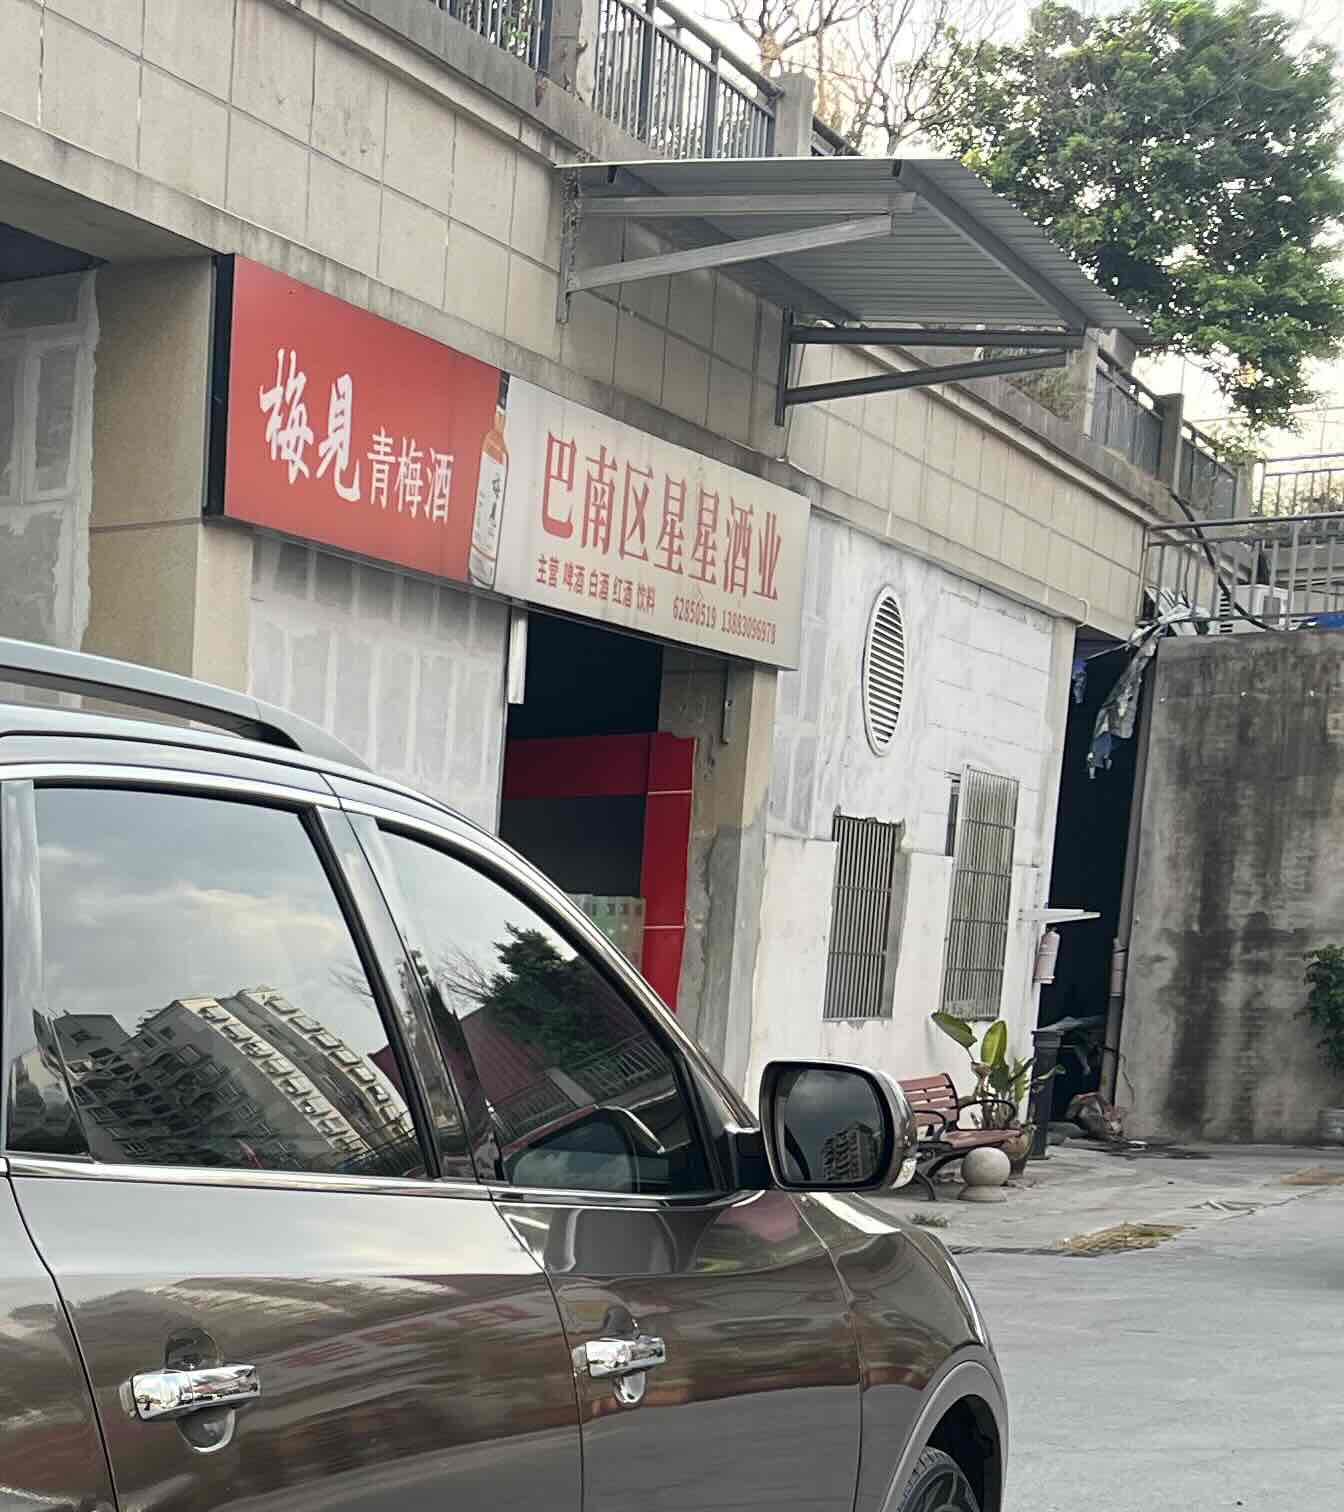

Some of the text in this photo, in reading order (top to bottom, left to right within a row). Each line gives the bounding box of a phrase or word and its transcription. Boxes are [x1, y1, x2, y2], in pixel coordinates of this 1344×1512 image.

[367, 425, 454, 524] 青梅酒
[542, 431, 782, 600] 巴南区星星酒业
[536, 553, 559, 588] 主营
[563, 561, 585, 594] 啤酒
[590, 570, 609, 600] 白酒
[612, 576, 633, 608] 红酒
[637, 582, 656, 614] 饮料
